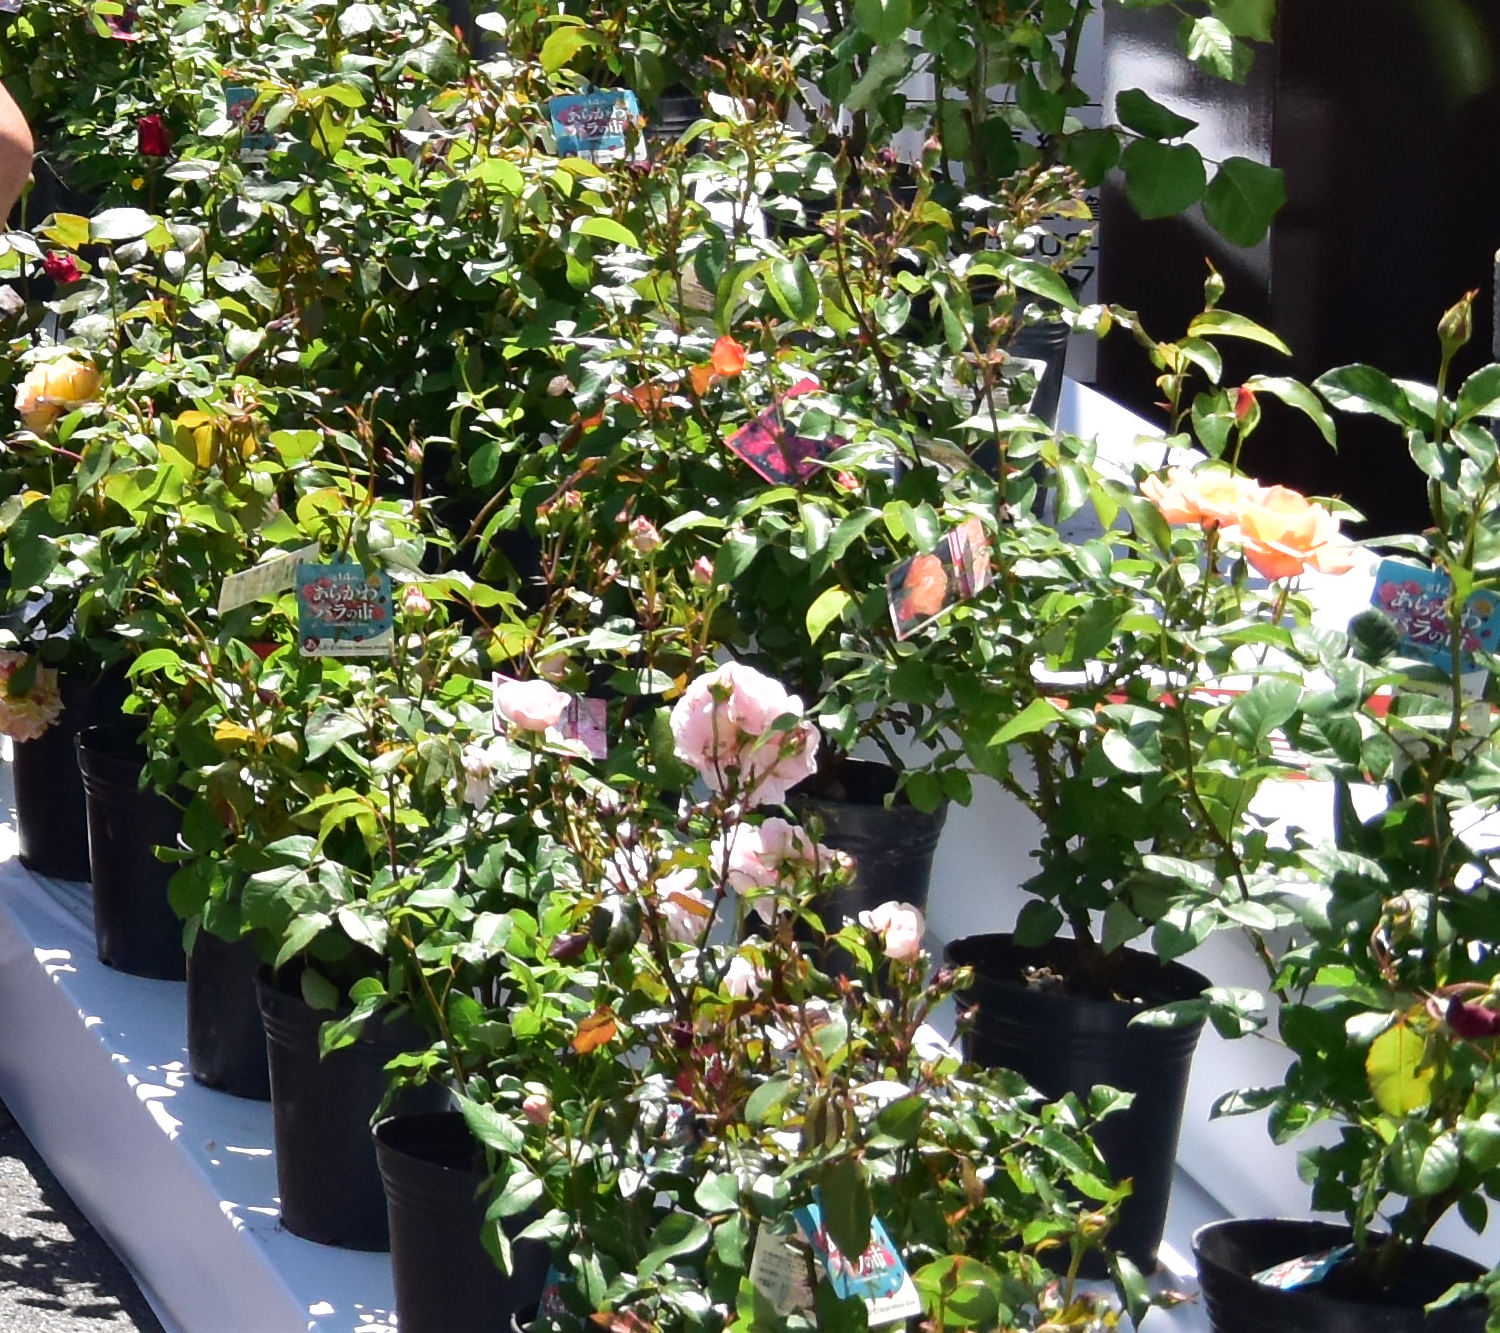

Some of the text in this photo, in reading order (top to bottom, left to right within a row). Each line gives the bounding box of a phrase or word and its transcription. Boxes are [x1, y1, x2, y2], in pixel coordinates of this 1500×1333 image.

[312, 583, 378, 602] あらかわ
[314, 602, 374, 621] バラの市
